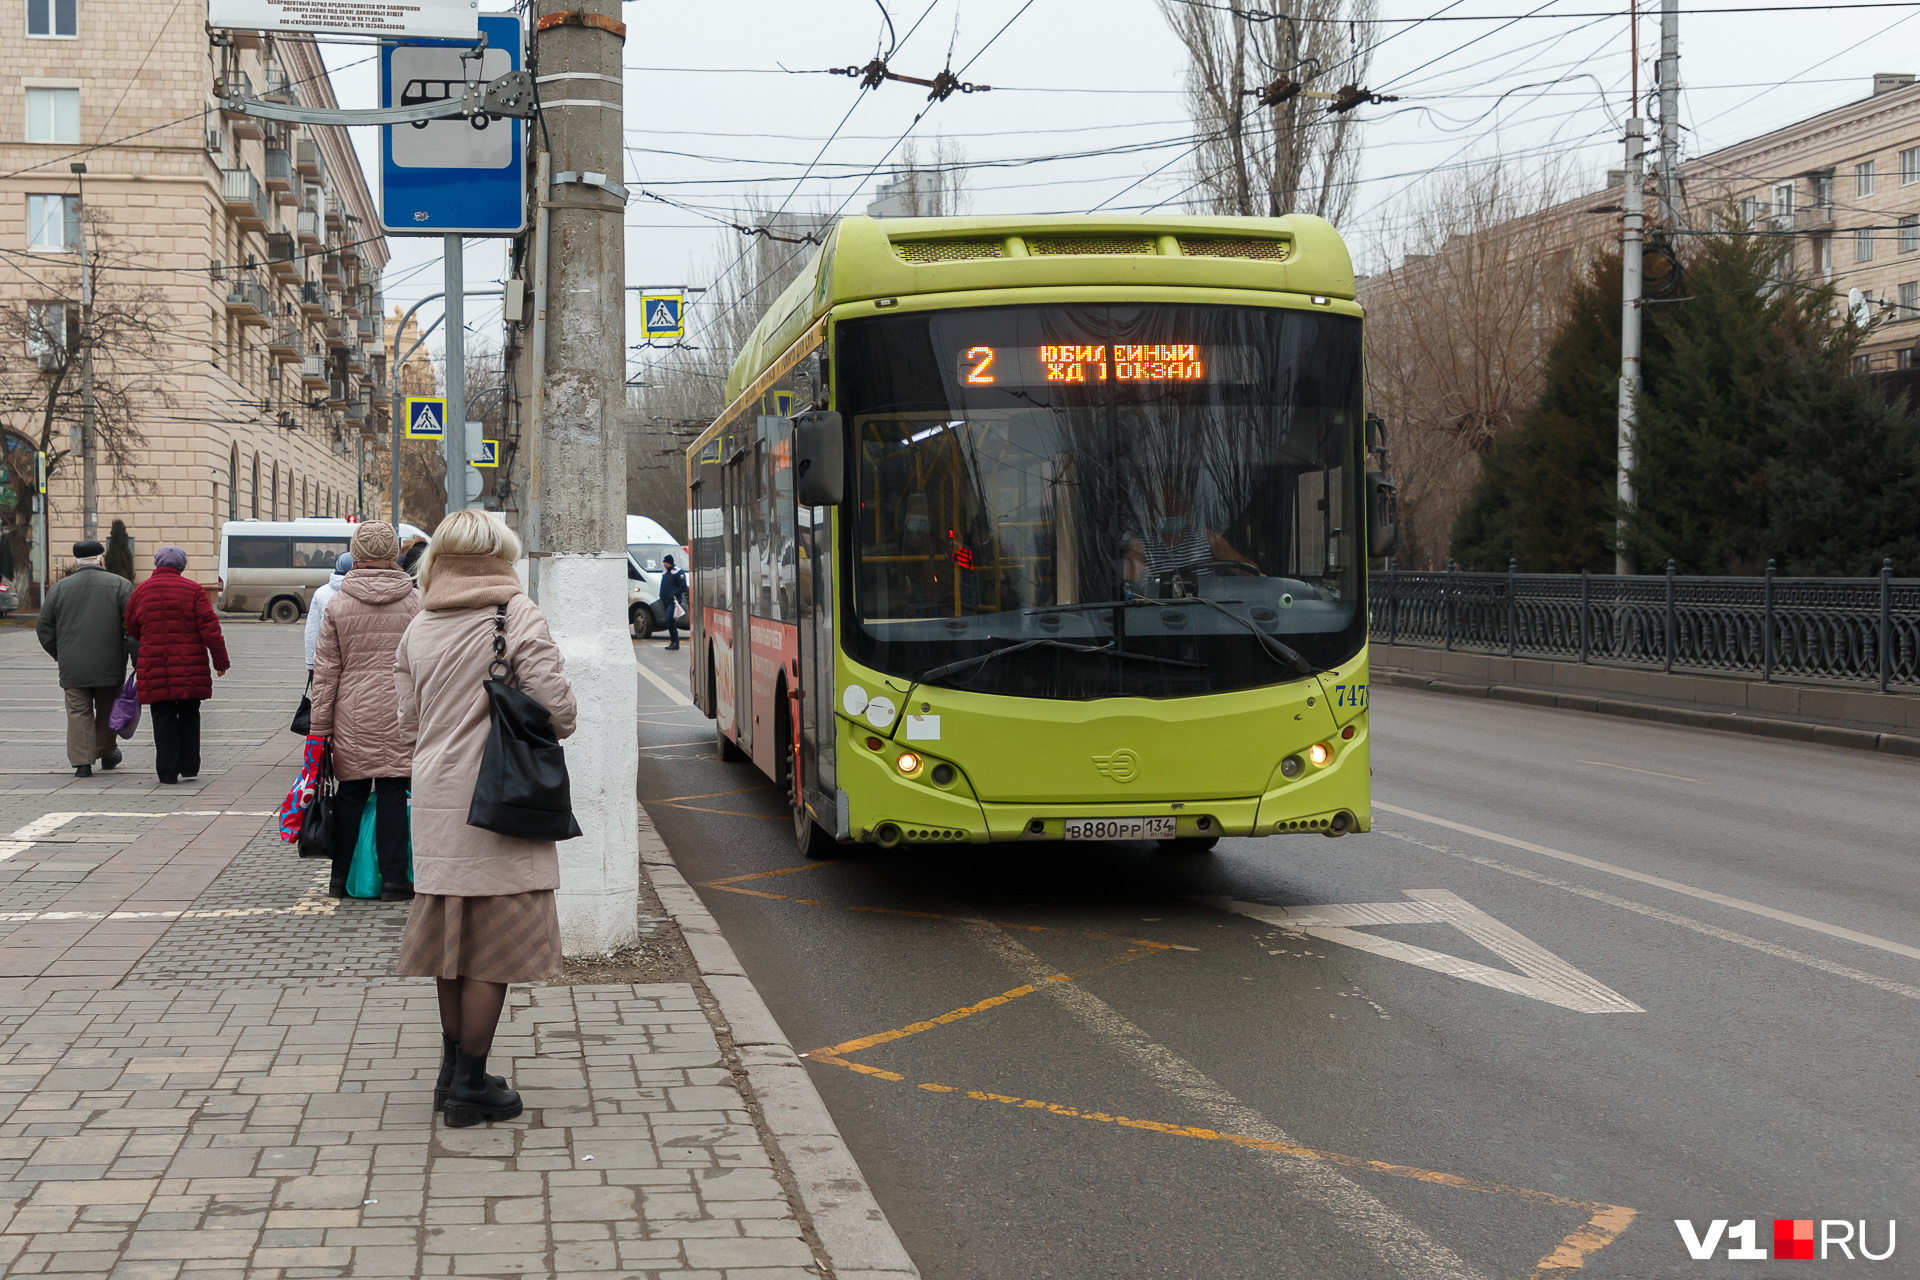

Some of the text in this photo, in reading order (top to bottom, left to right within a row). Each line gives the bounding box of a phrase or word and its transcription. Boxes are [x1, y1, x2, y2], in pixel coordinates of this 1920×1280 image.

[968, 346, 993, 383] 2
[1048, 363, 1084, 383] ЖД
[1145, 819, 1172, 832] 134
